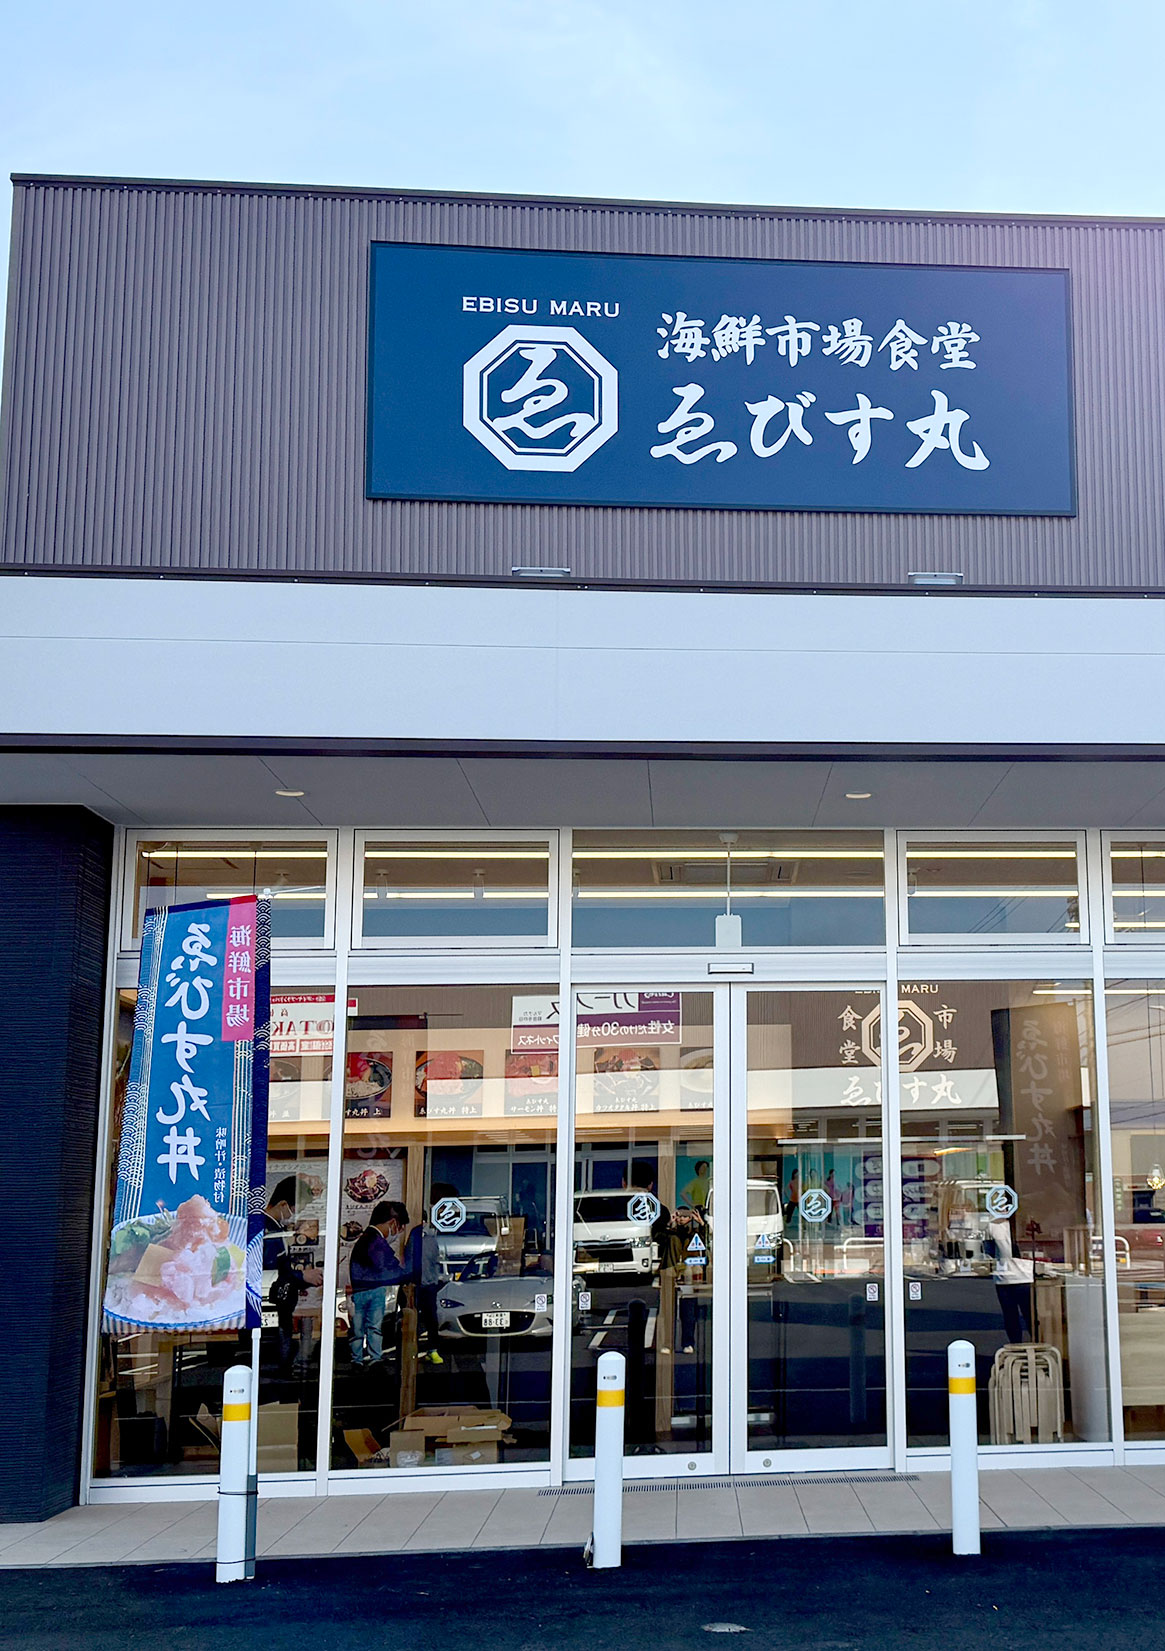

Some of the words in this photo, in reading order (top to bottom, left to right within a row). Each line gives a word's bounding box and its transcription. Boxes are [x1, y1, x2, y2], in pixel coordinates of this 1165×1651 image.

[462, 296, 538, 316] EBISU
[550, 298, 621, 318] MARU
[656, 311, 981, 371] 海鮮市場食堂
[649, 381, 991, 471] ゑびす丸
[901, 984, 939, 994] MARU
[838, 1004, 863, 1065] 食堂
[933, 1004, 958, 1064] 市場
